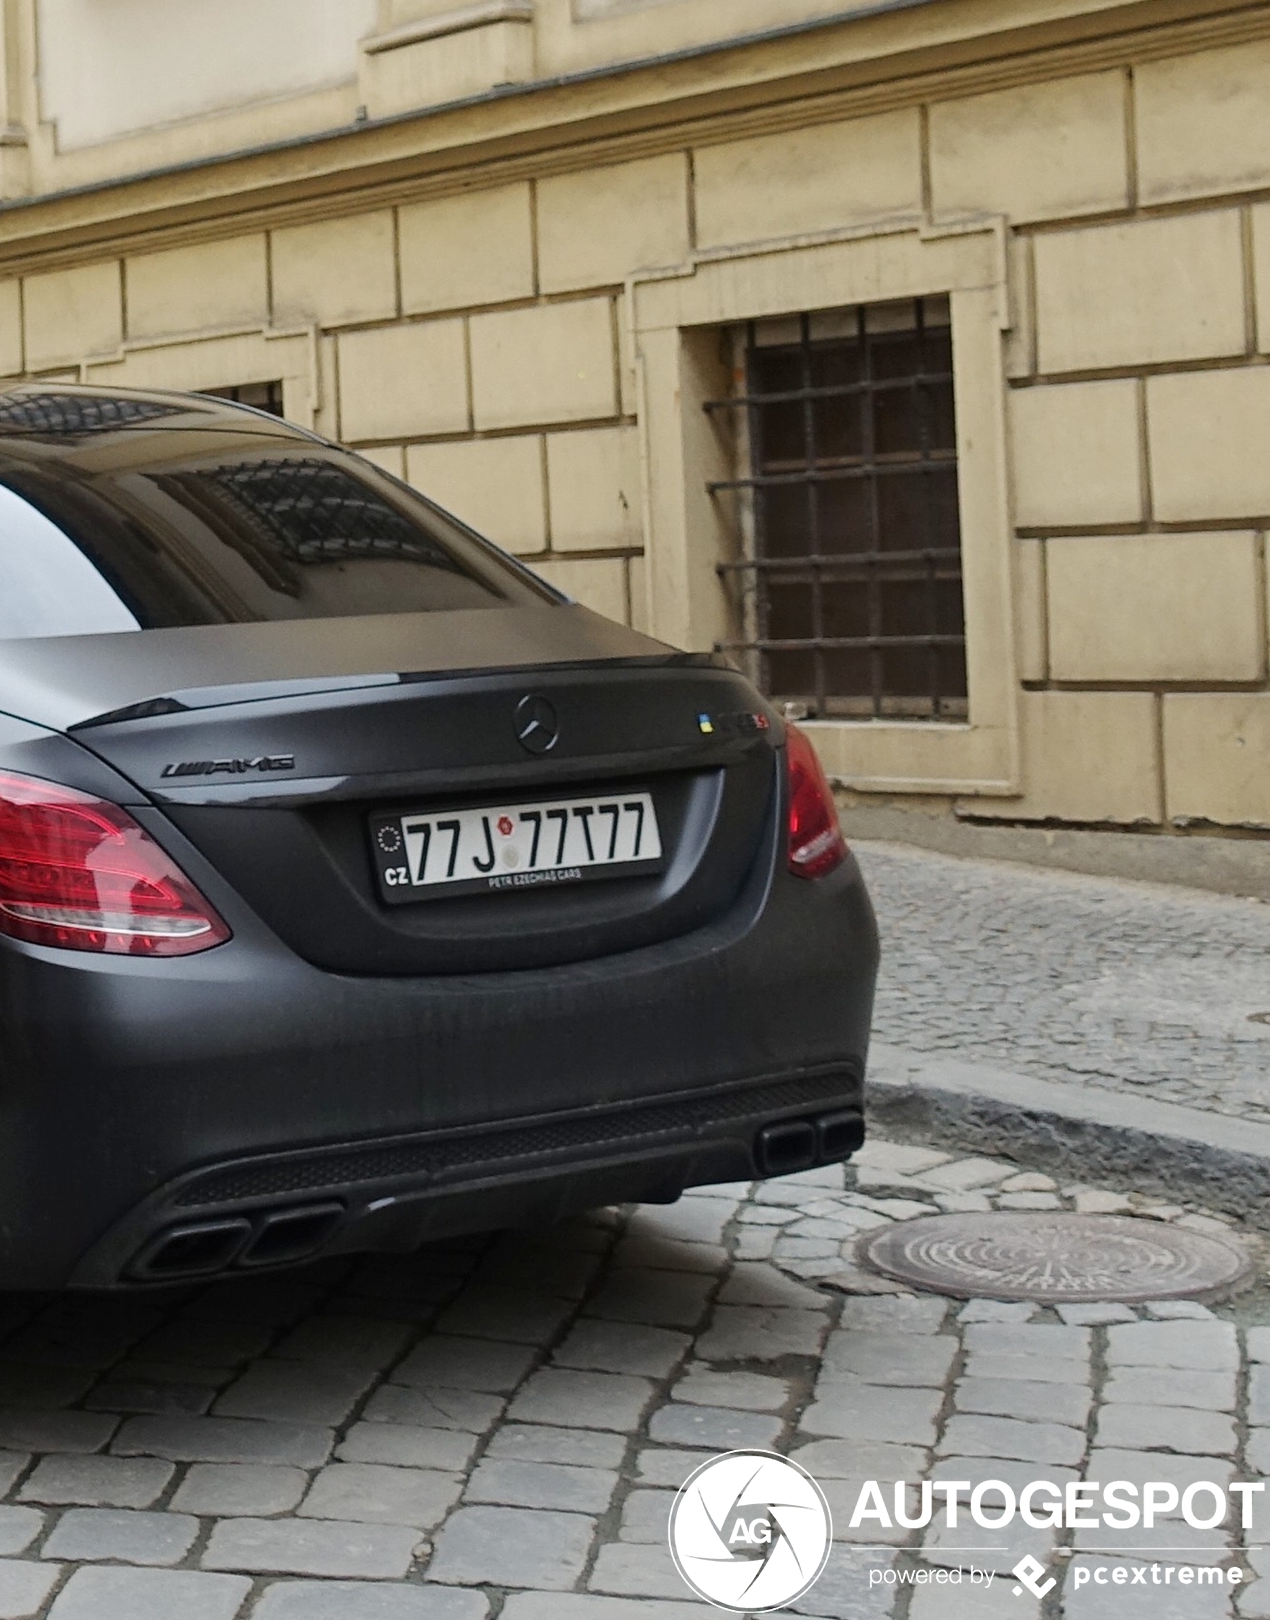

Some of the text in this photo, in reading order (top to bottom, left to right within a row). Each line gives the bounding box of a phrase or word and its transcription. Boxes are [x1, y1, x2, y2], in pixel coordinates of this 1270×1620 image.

[203, 754, 295, 774] AMG
[384, 867, 409, 886] CZ
[488, 876, 512, 888] PETR
[557, 868, 582, 880] CARS
